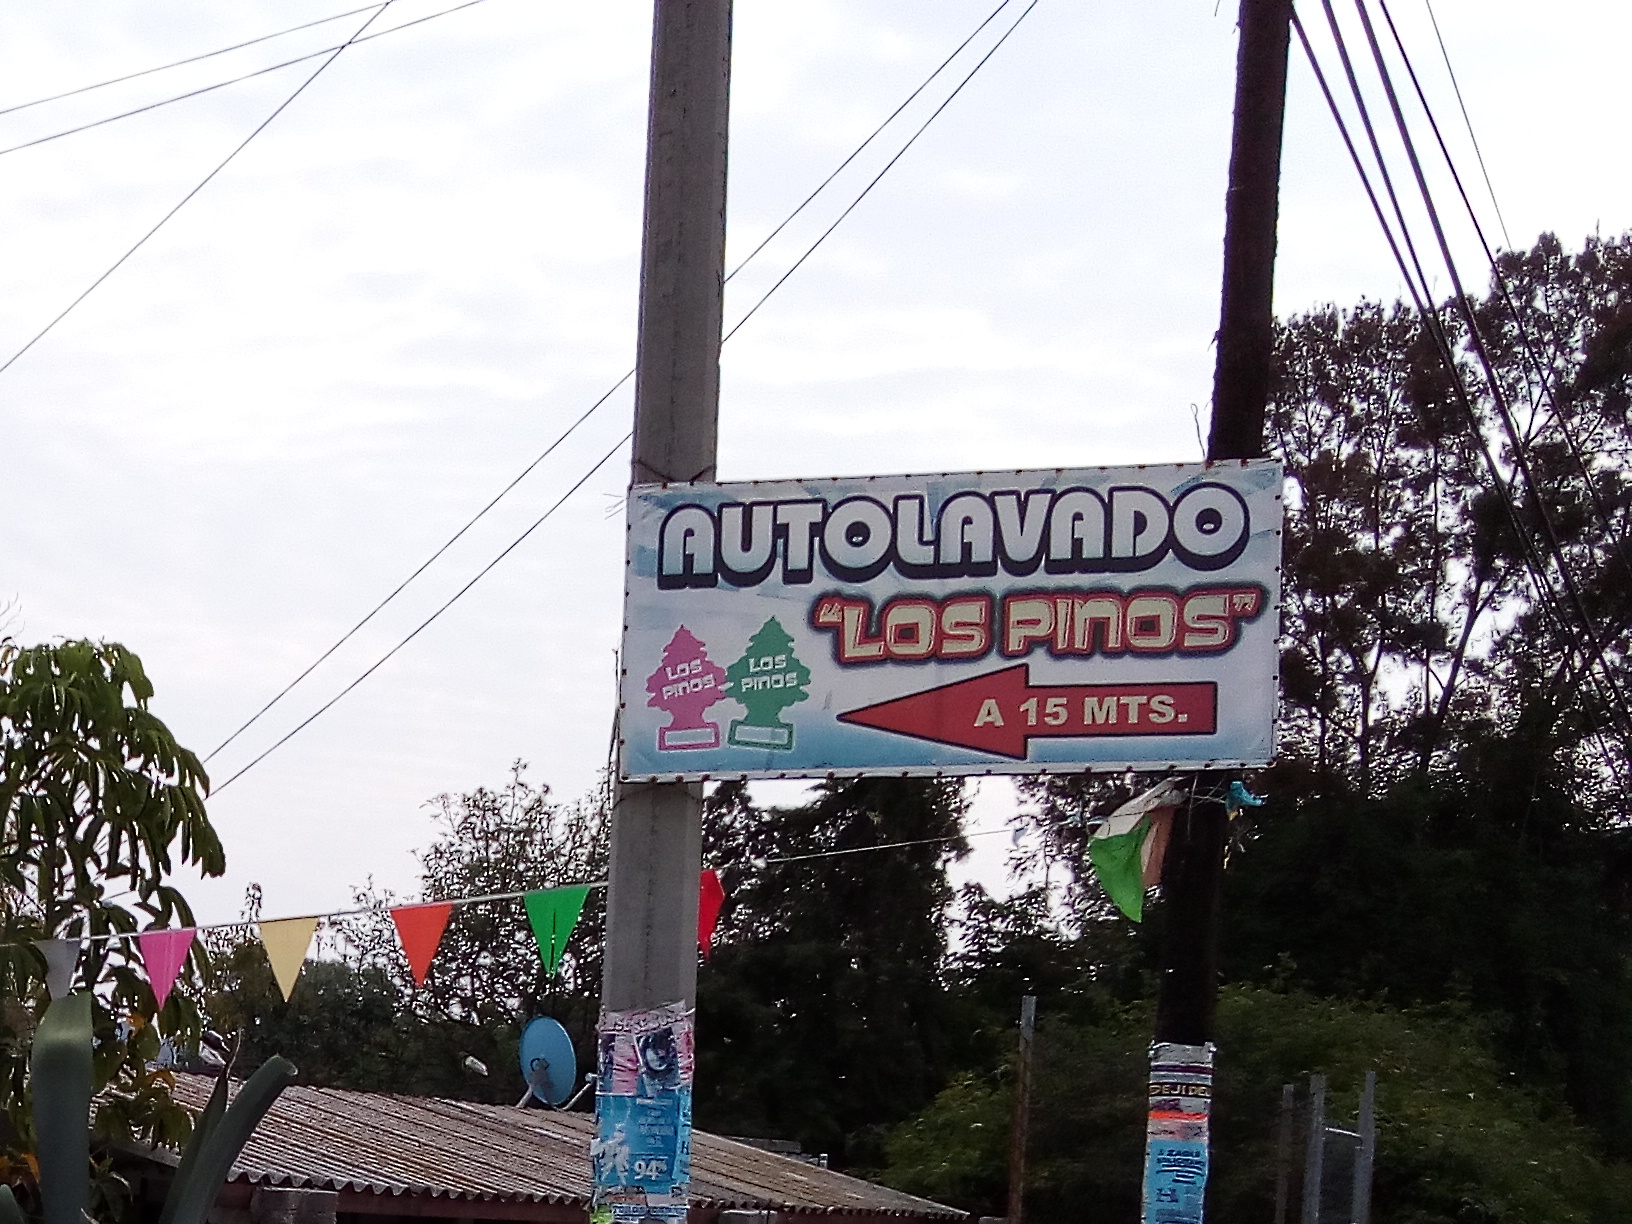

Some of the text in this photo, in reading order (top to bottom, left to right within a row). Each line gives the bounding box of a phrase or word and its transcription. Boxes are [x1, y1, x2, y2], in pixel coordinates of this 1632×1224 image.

[658, 482, 1251, 589] AUTOLAVADO
[666, 658, 703, 681] LOS
[749, 654, 787, 673] LOS
[662, 673, 716, 700] PINOS
[741, 671, 798, 692] PINOS
[974, 694, 1188, 727] A 15 MTS.
